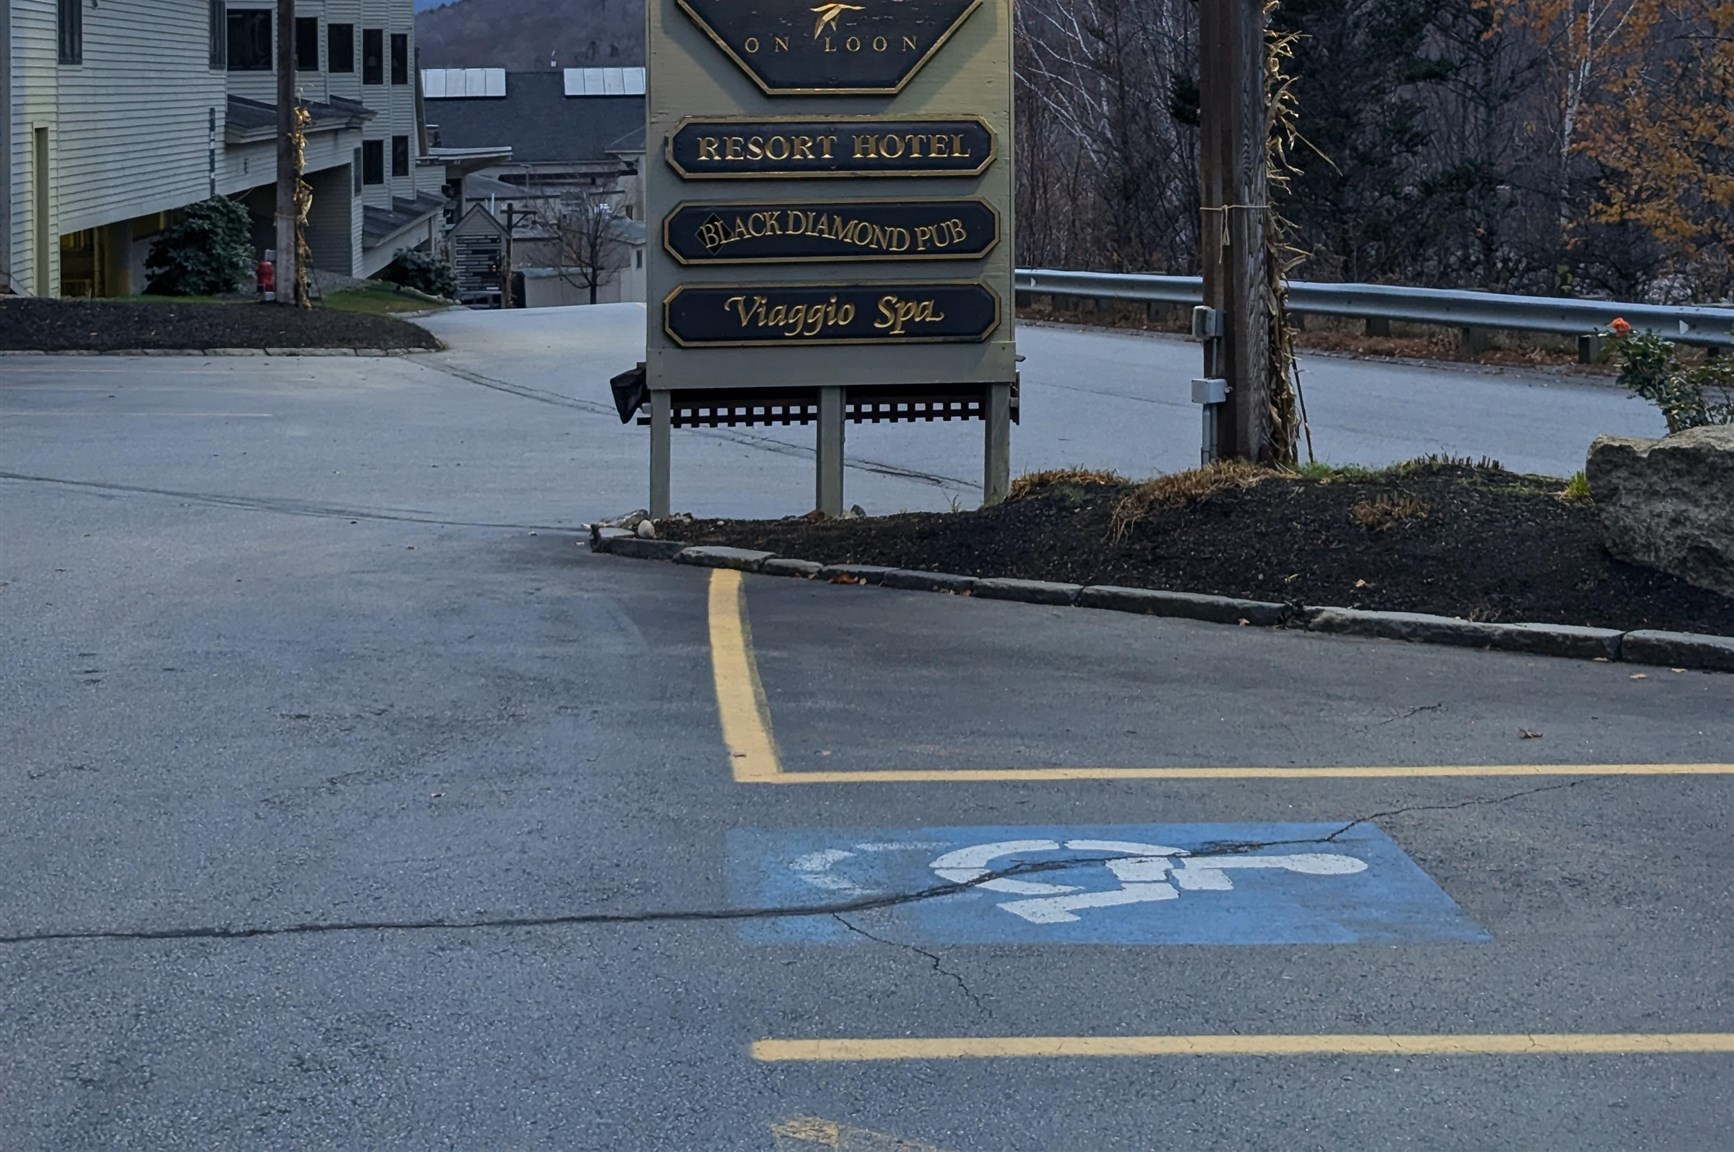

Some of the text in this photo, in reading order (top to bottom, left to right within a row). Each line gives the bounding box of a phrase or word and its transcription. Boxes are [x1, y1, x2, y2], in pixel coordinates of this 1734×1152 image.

[744, 35, 918, 53] ON LOON
[697, 134, 971, 161] RESORT HOTEL
[699, 209, 967, 252] BLACK DIAMOND PUB
[724, 293, 945, 337] Viaggio Spa
